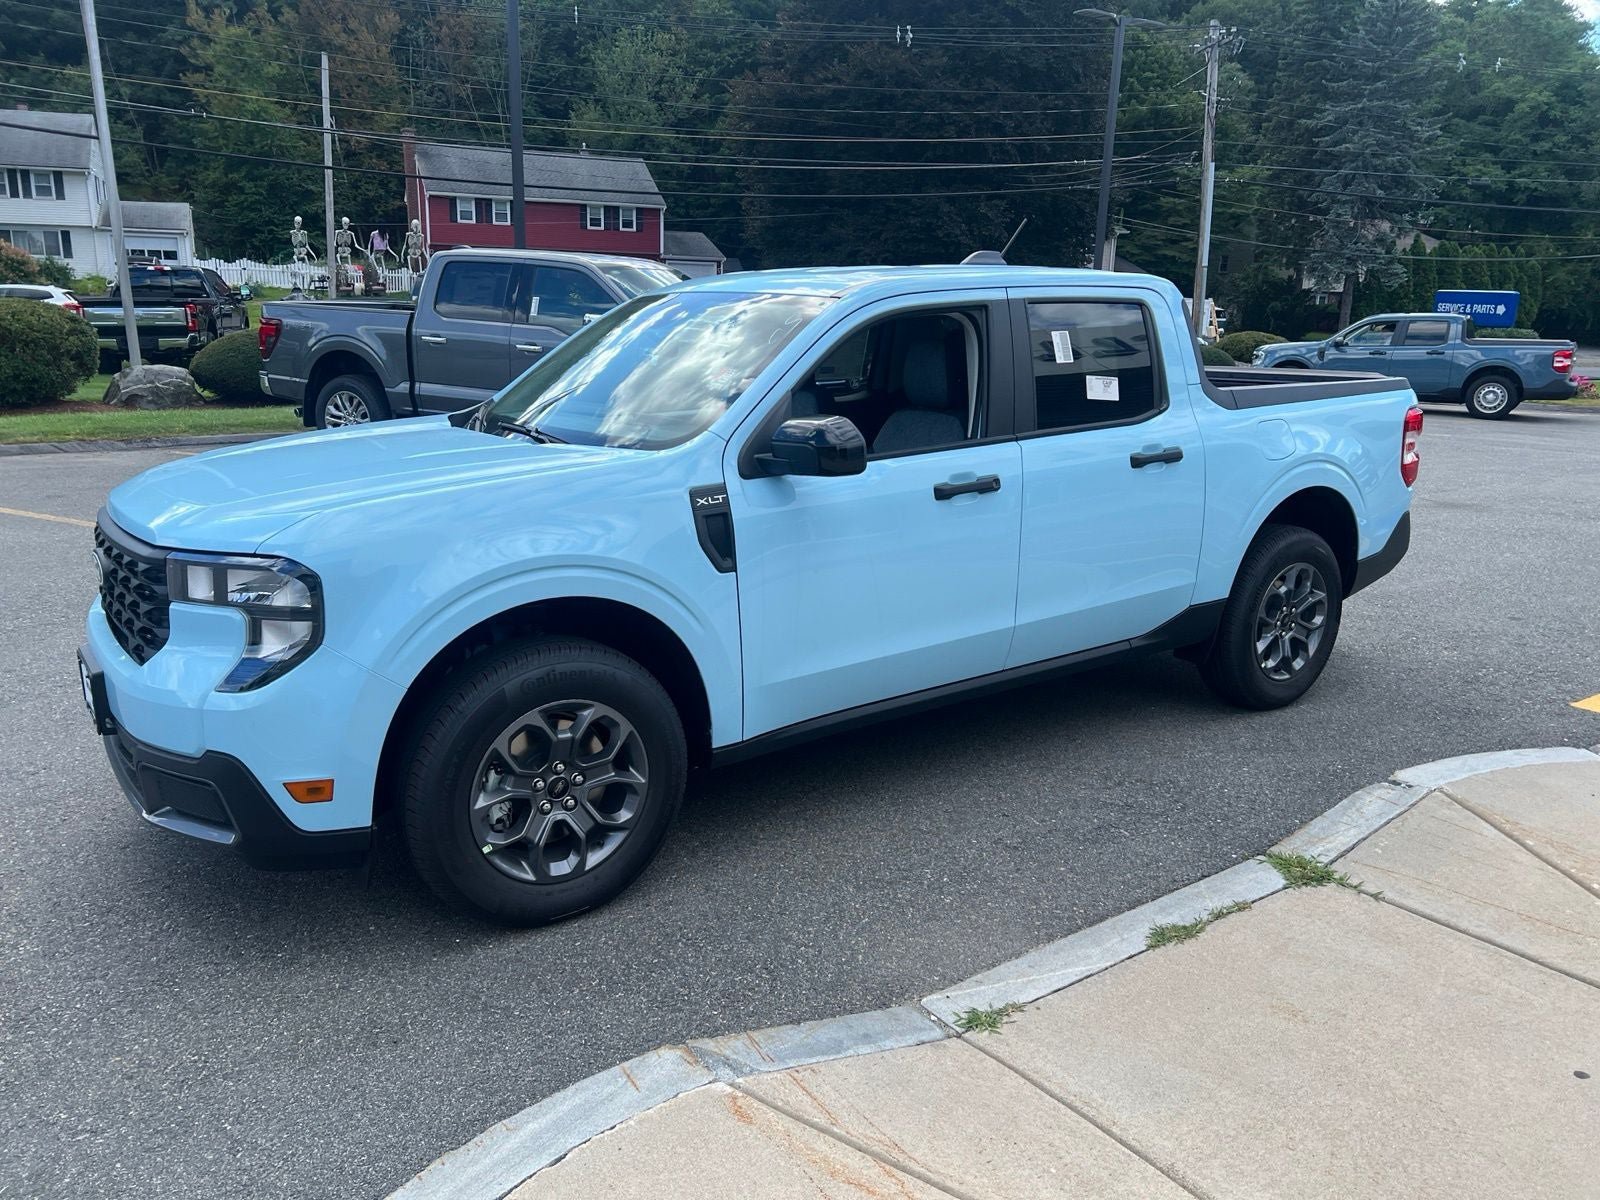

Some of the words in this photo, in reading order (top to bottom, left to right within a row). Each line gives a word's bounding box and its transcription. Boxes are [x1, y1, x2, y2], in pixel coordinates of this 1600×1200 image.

[1437, 303, 1465, 313] SERVICE
[1466, 304, 1471, 313] &
[1472, 304, 1495, 314] PARTS
[696, 494, 727, 507] XLT
